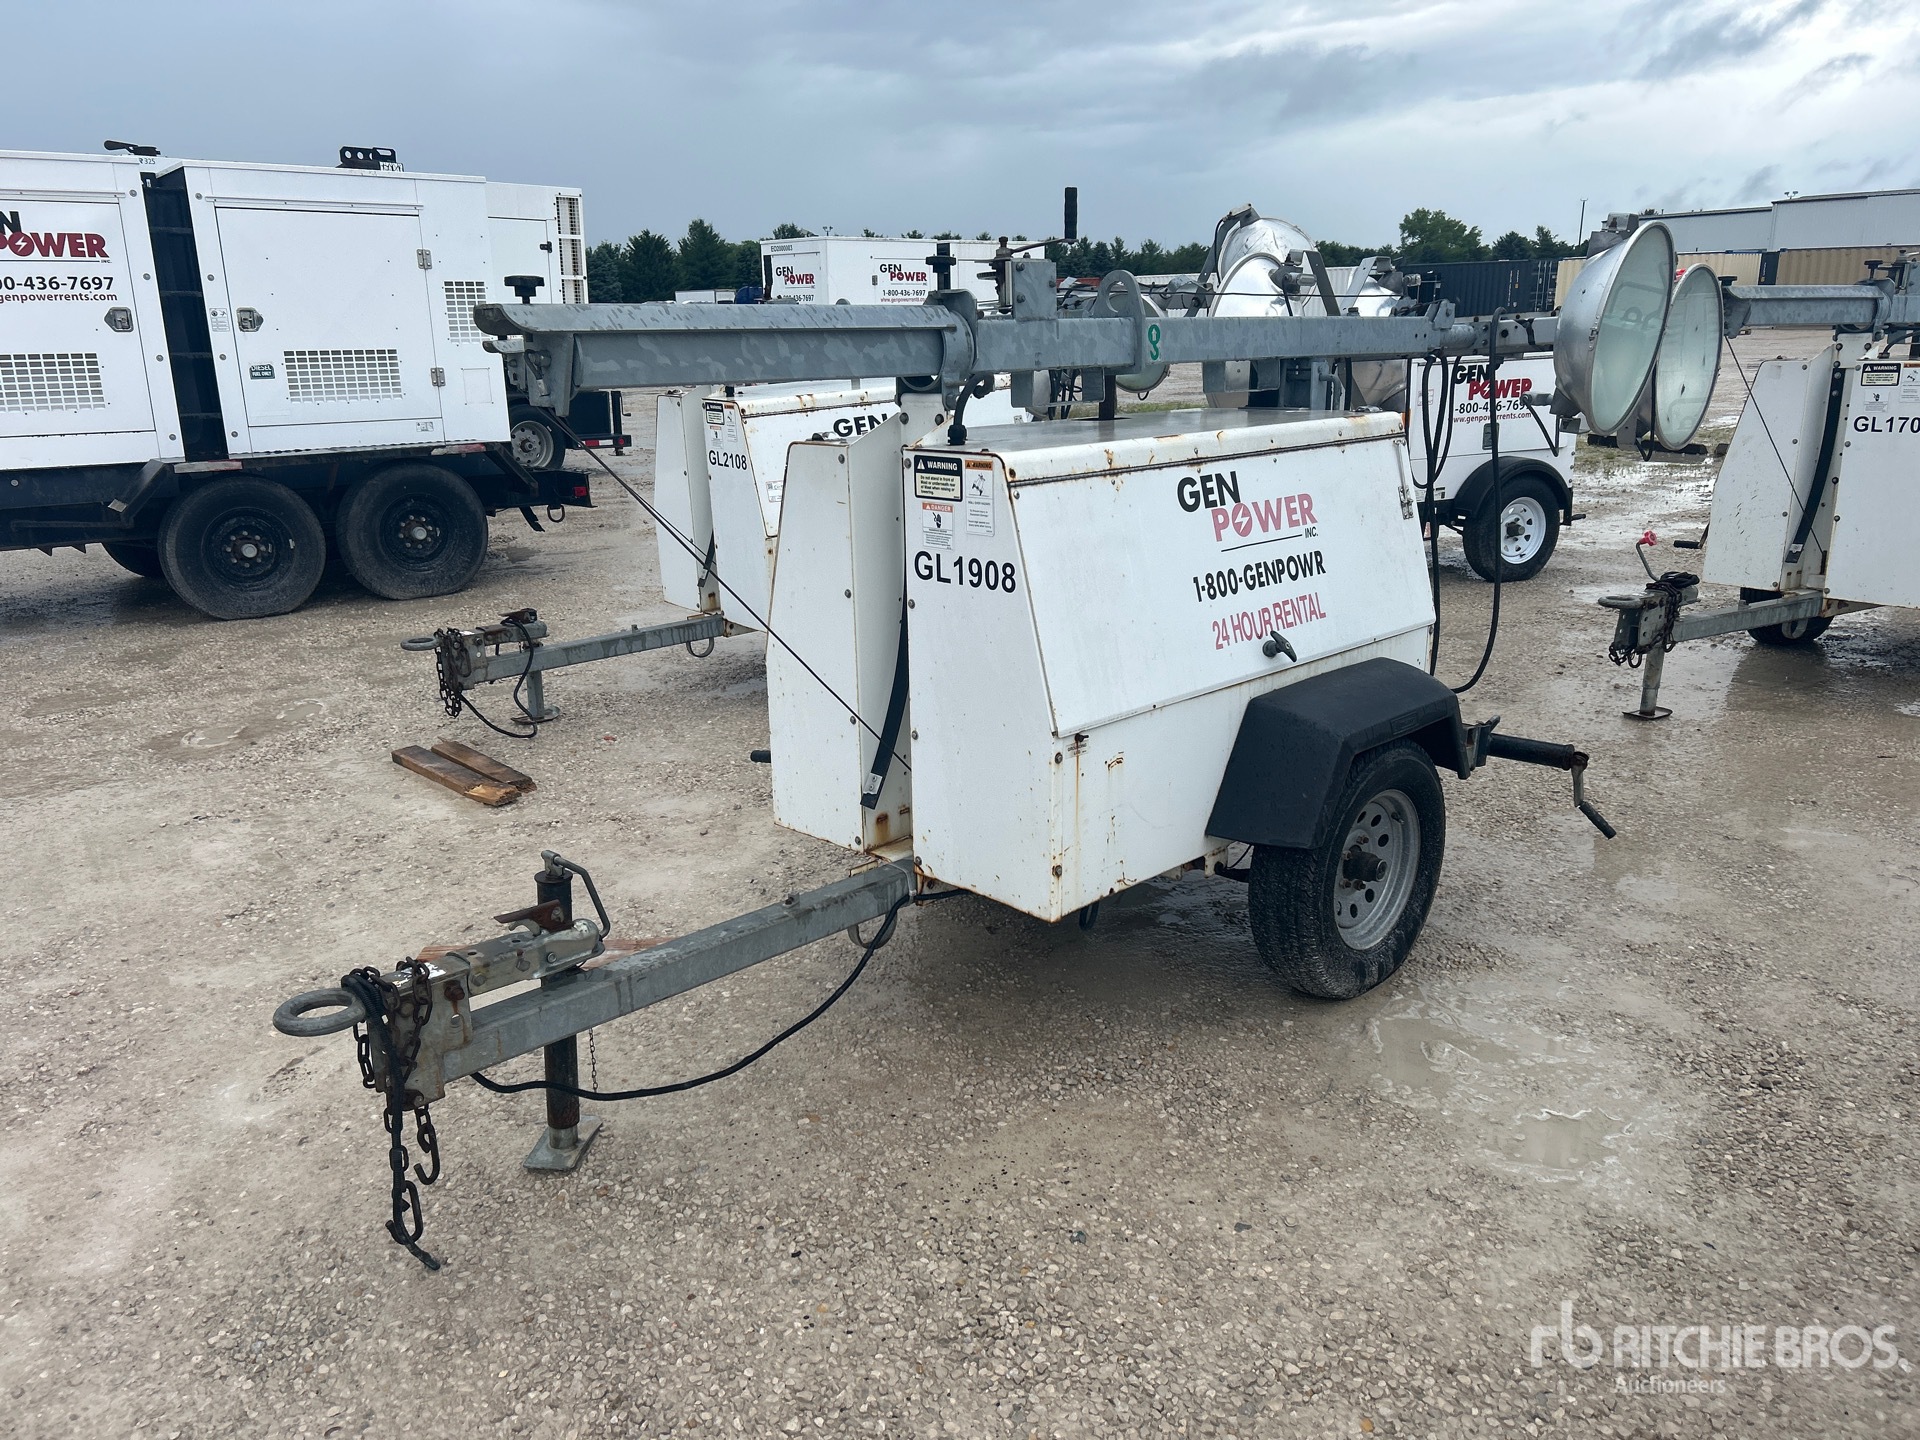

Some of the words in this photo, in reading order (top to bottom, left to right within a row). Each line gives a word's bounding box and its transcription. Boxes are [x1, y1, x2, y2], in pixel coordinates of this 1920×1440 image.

[776, 266, 794, 277] GEN
[880, 264, 902, 273] GEN
[784, 273, 815, 285] POWER
[890, 271, 927, 281] POWER
[0, 276, 114, 290] 0-436-7697
[709, 450, 747, 470] GL2108
[927, 460, 958, 471] WARNING
[1177, 471, 1241, 512] GEN
[930, 504, 951, 512] DANGER
[1211, 493, 1318, 542] POWER
[1304, 526, 1319, 538] INC.
[914, 551, 1016, 593] GL1908
[1193, 550, 1326, 602] 1-800-GENPOWR
[1212, 618, 1230, 650] 24
[1230, 607, 1273, 643] HOUR
[1272, 592, 1326, 631] RENTAL
